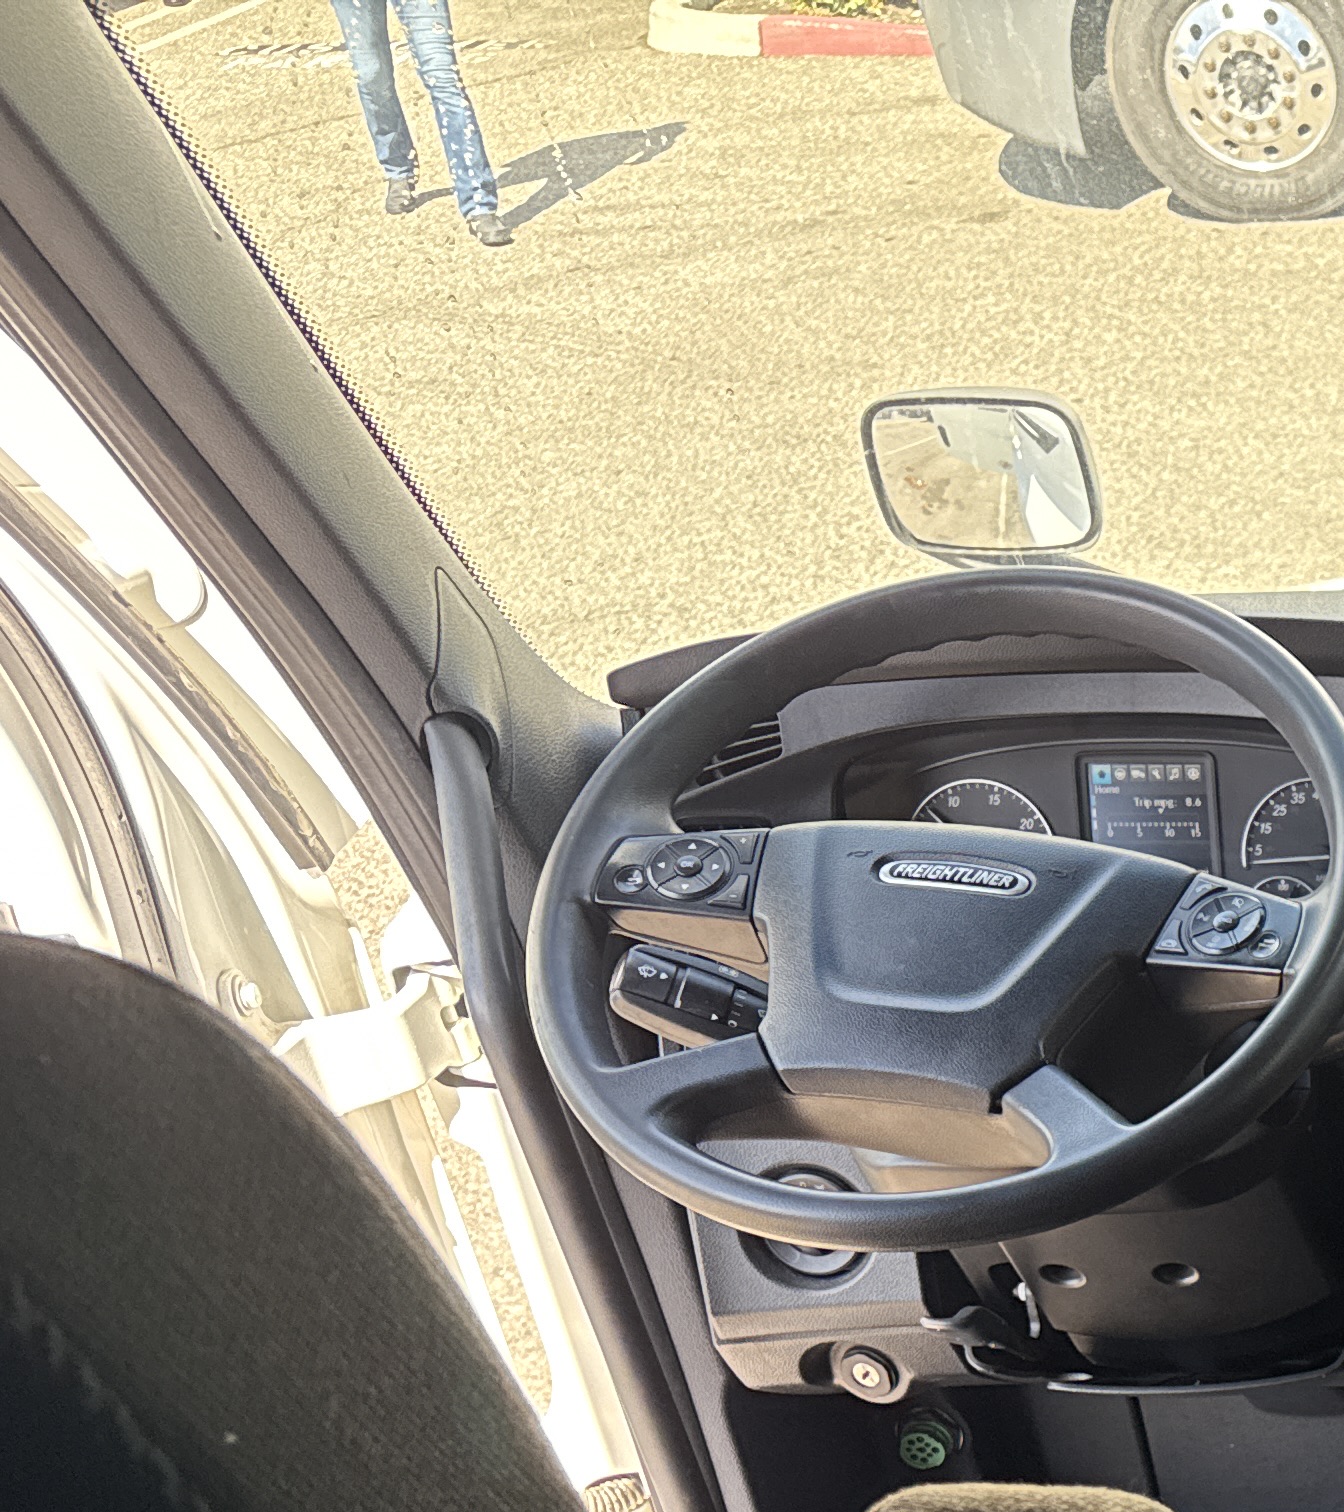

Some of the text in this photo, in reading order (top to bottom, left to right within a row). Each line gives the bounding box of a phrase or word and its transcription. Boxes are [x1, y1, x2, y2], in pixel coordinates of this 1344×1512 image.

[1094, 785, 1120, 795] Home
[947, 796, 960, 808] 10
[988, 794, 1001, 806] 15
[1133, 797, 1152, 809] Trip
[1185, 797, 1202, 807] 8.6
[1290, 792, 1306, 804] 35
[1272, 804, 1287, 816] 25
[1019, 818, 1035, 831] 20
[1259, 822, 1272, 834] 15
[1164, 828, 1176, 838] 10
[1190, 828, 1202, 838] 15
[1253, 844, 1263, 856] 5
[892, 863, 1016, 889] FREIGHTLINER
